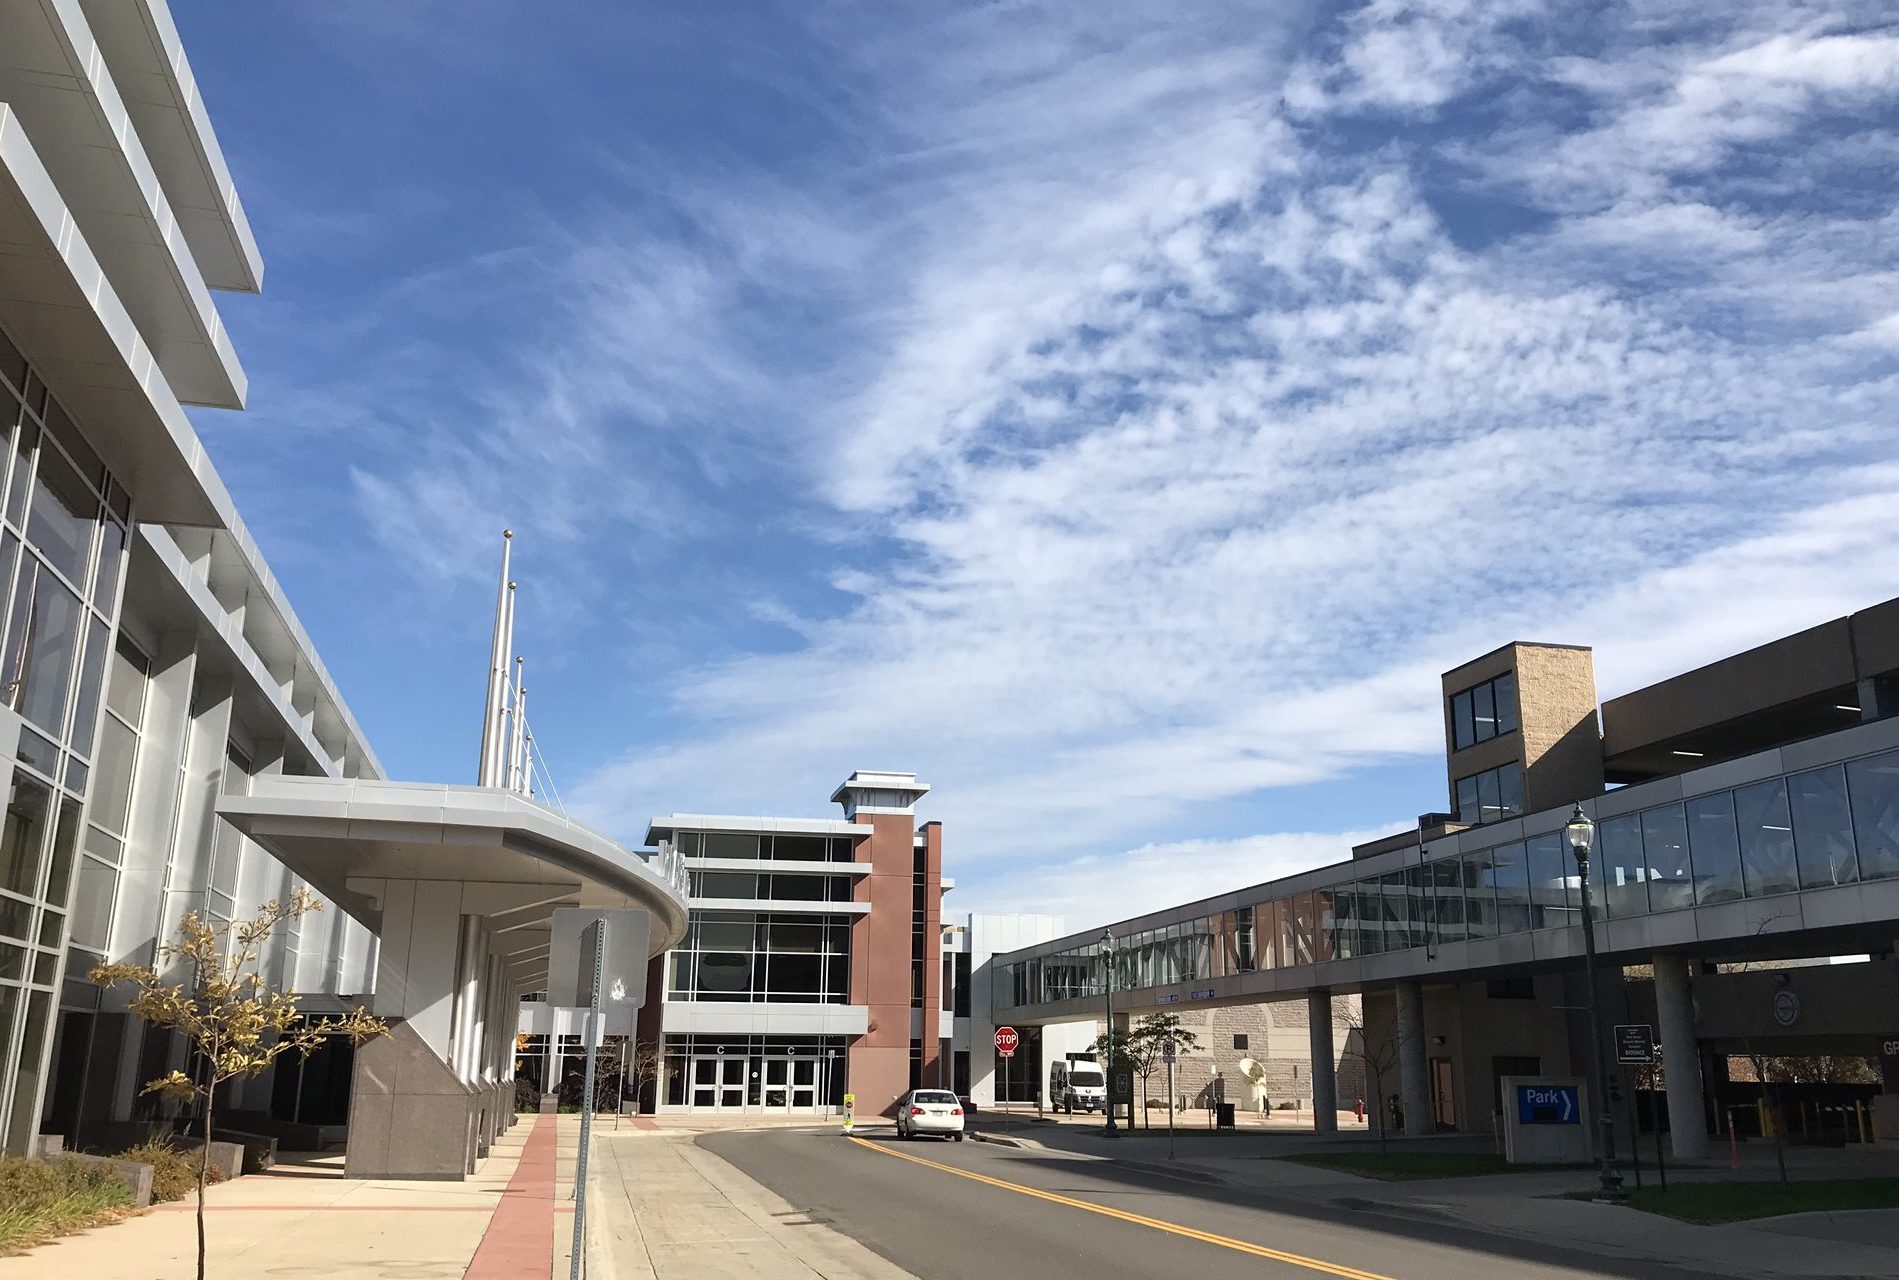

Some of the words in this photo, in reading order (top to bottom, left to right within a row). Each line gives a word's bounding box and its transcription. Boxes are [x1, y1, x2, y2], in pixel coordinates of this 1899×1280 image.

[996, 1034, 1016, 1045] STOP
[716, 1046, 725, 1055] C
[787, 1046, 795, 1055] C
[1527, 1089, 1559, 1104] Park
